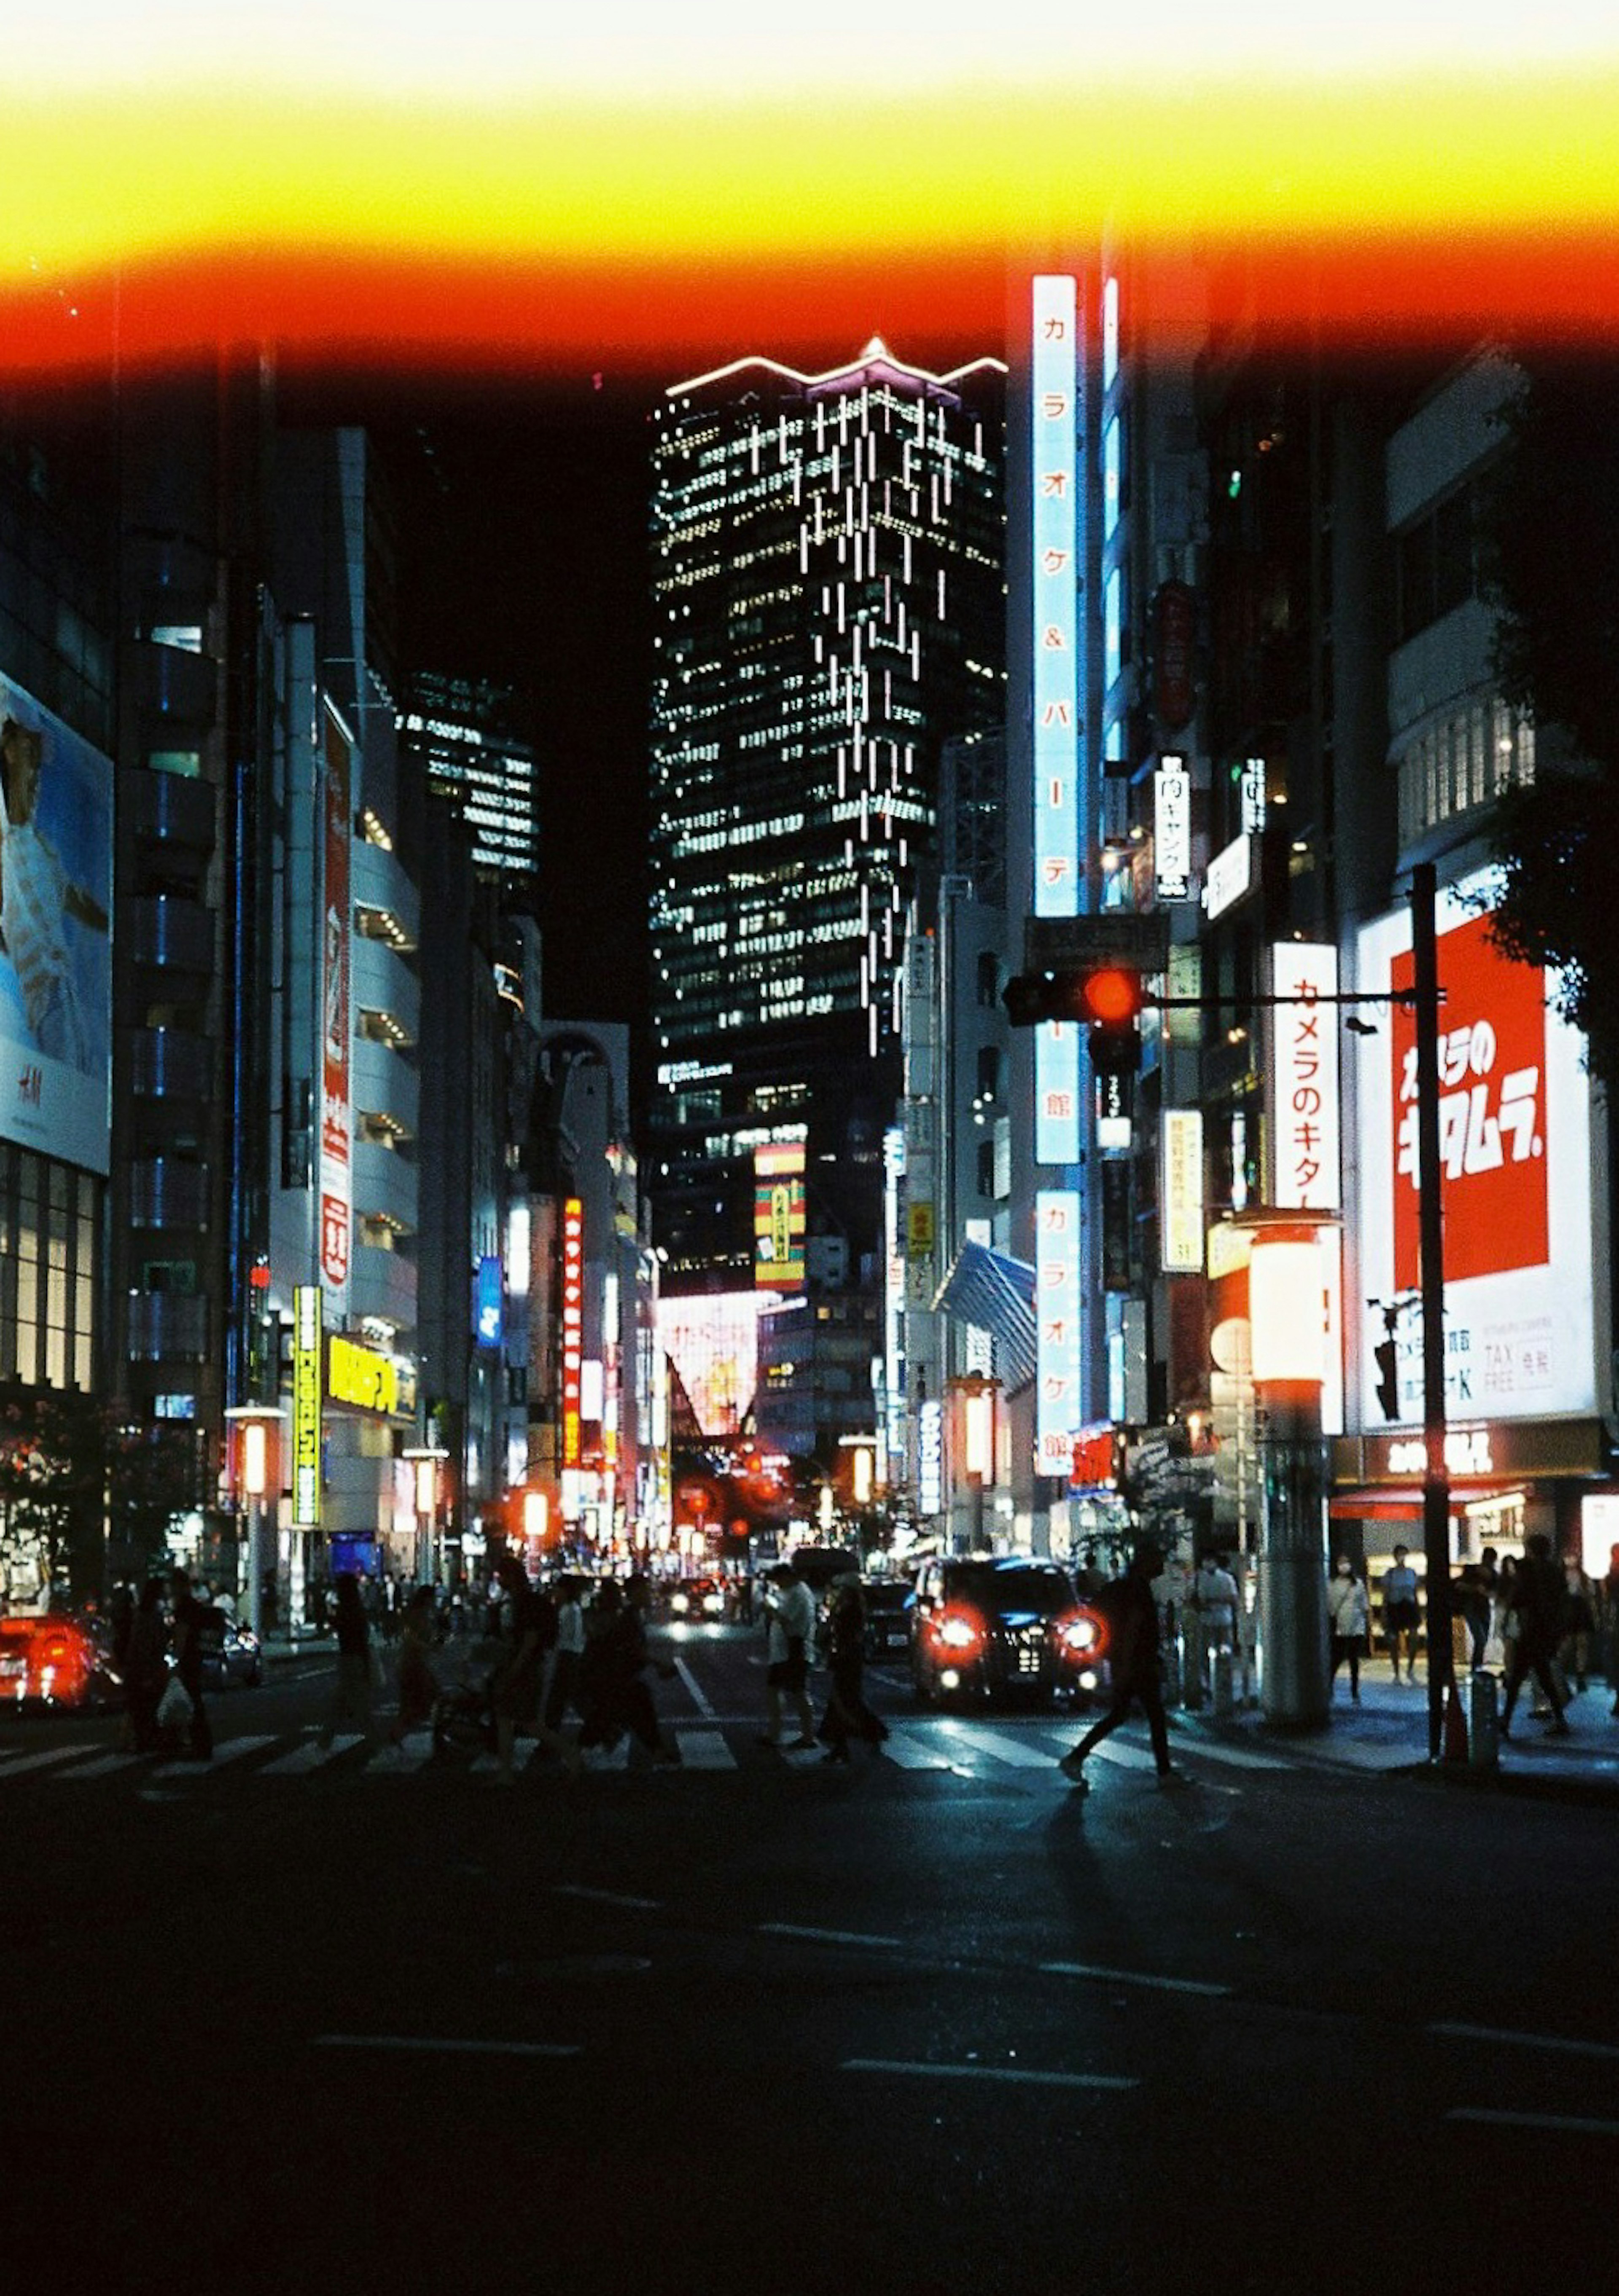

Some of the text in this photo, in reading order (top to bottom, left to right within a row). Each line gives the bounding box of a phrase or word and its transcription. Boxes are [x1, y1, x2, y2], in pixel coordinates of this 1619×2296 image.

[1293, 979, 1320, 1208] カメラのキタ
[1485, 1344, 1513, 1367] TAX
